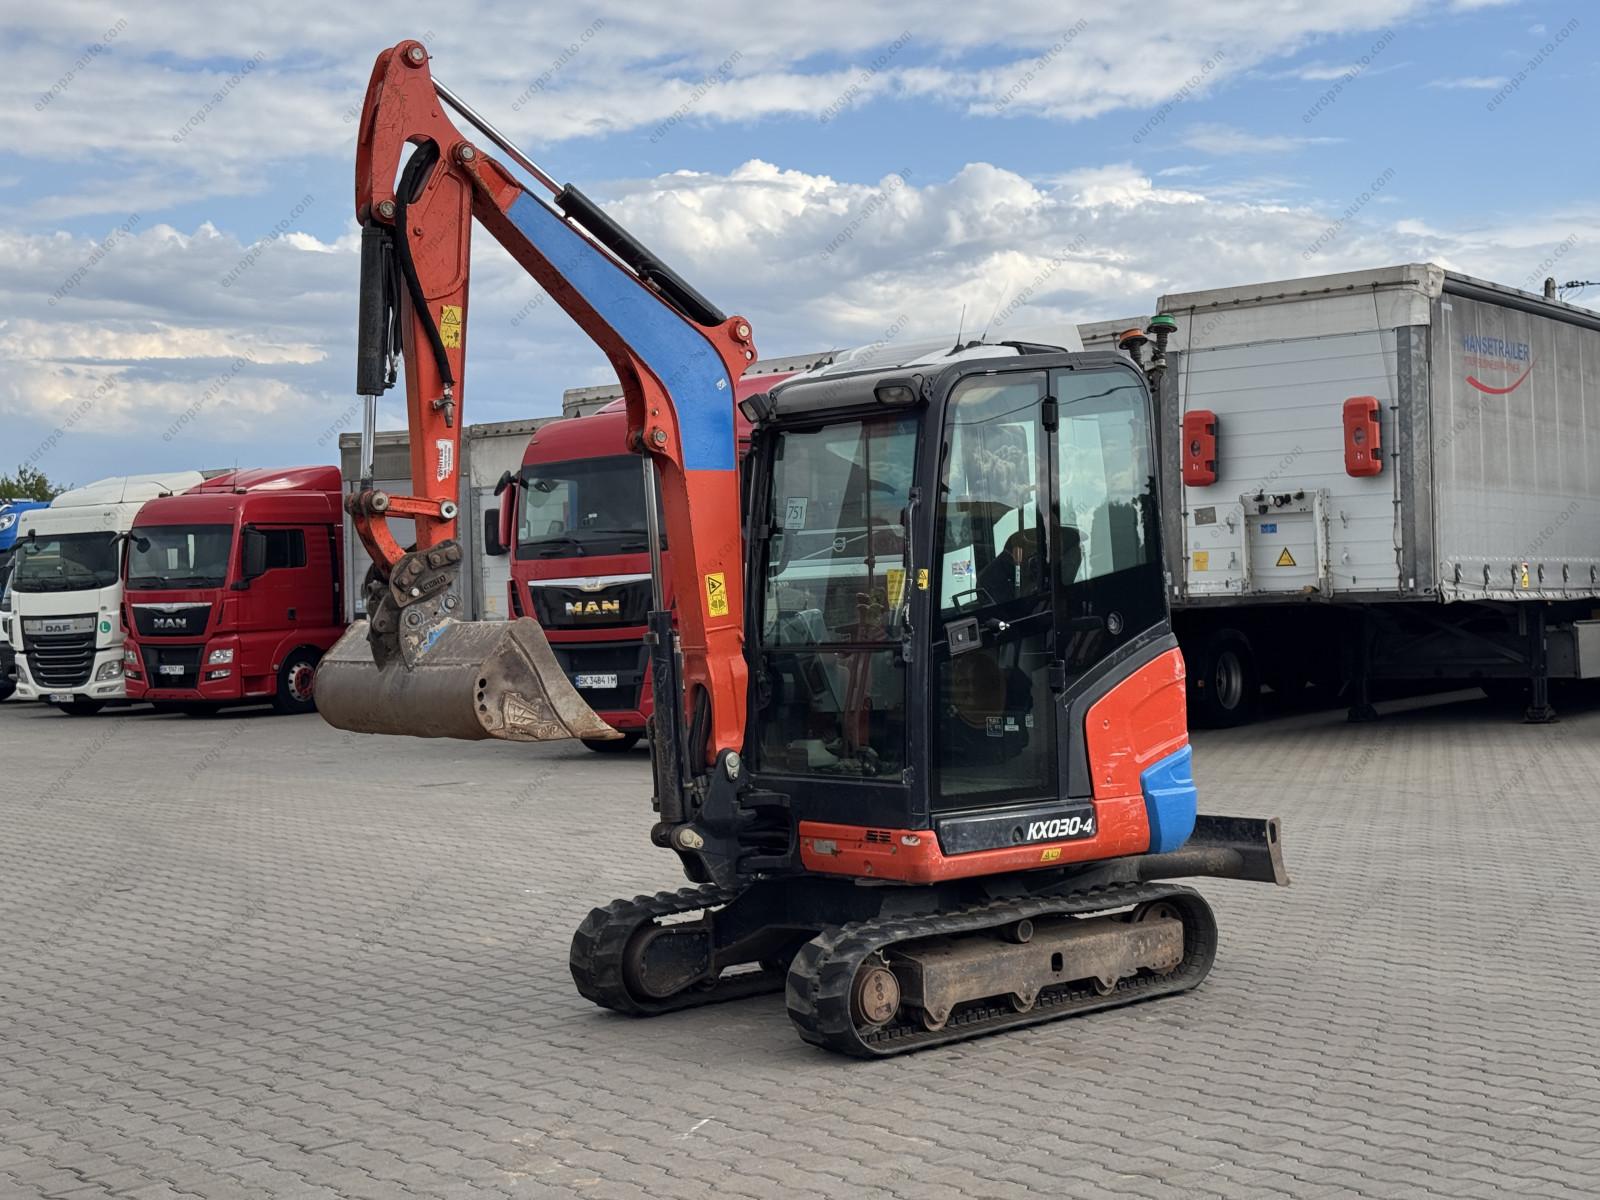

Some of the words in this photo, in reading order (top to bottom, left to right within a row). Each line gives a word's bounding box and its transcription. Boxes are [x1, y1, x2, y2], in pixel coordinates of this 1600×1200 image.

[1463, 336, 1530, 361] HANSETRAILER
[787, 505, 803, 519] 751
[565, 600, 620, 615] MAN
[45, 624, 71, 633] DAF
[153, 618, 187, 628] MAN
[590, 676, 606, 685] 3484
[1026, 816, 1094, 841] KX030-4
